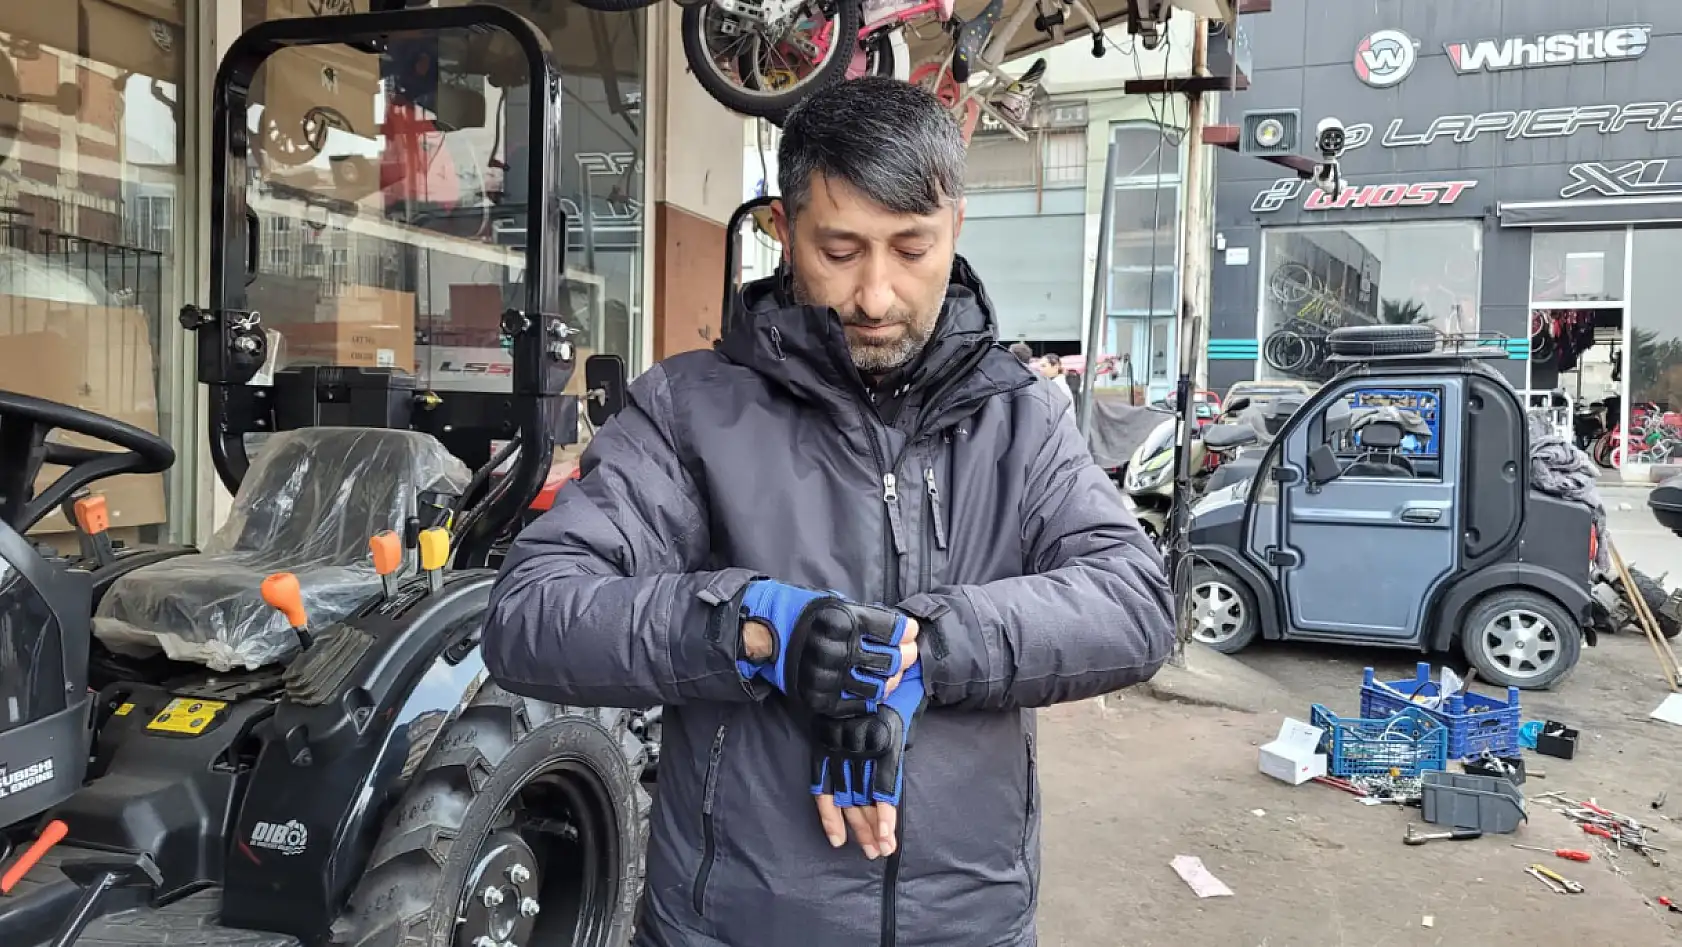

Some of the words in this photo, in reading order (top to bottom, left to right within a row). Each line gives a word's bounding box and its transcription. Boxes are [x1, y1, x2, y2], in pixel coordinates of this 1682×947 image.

[1446, 26, 1650, 72] Whistle
[1304, 181, 1477, 210] GHOST
[0, 758, 53, 788] UBISHI
